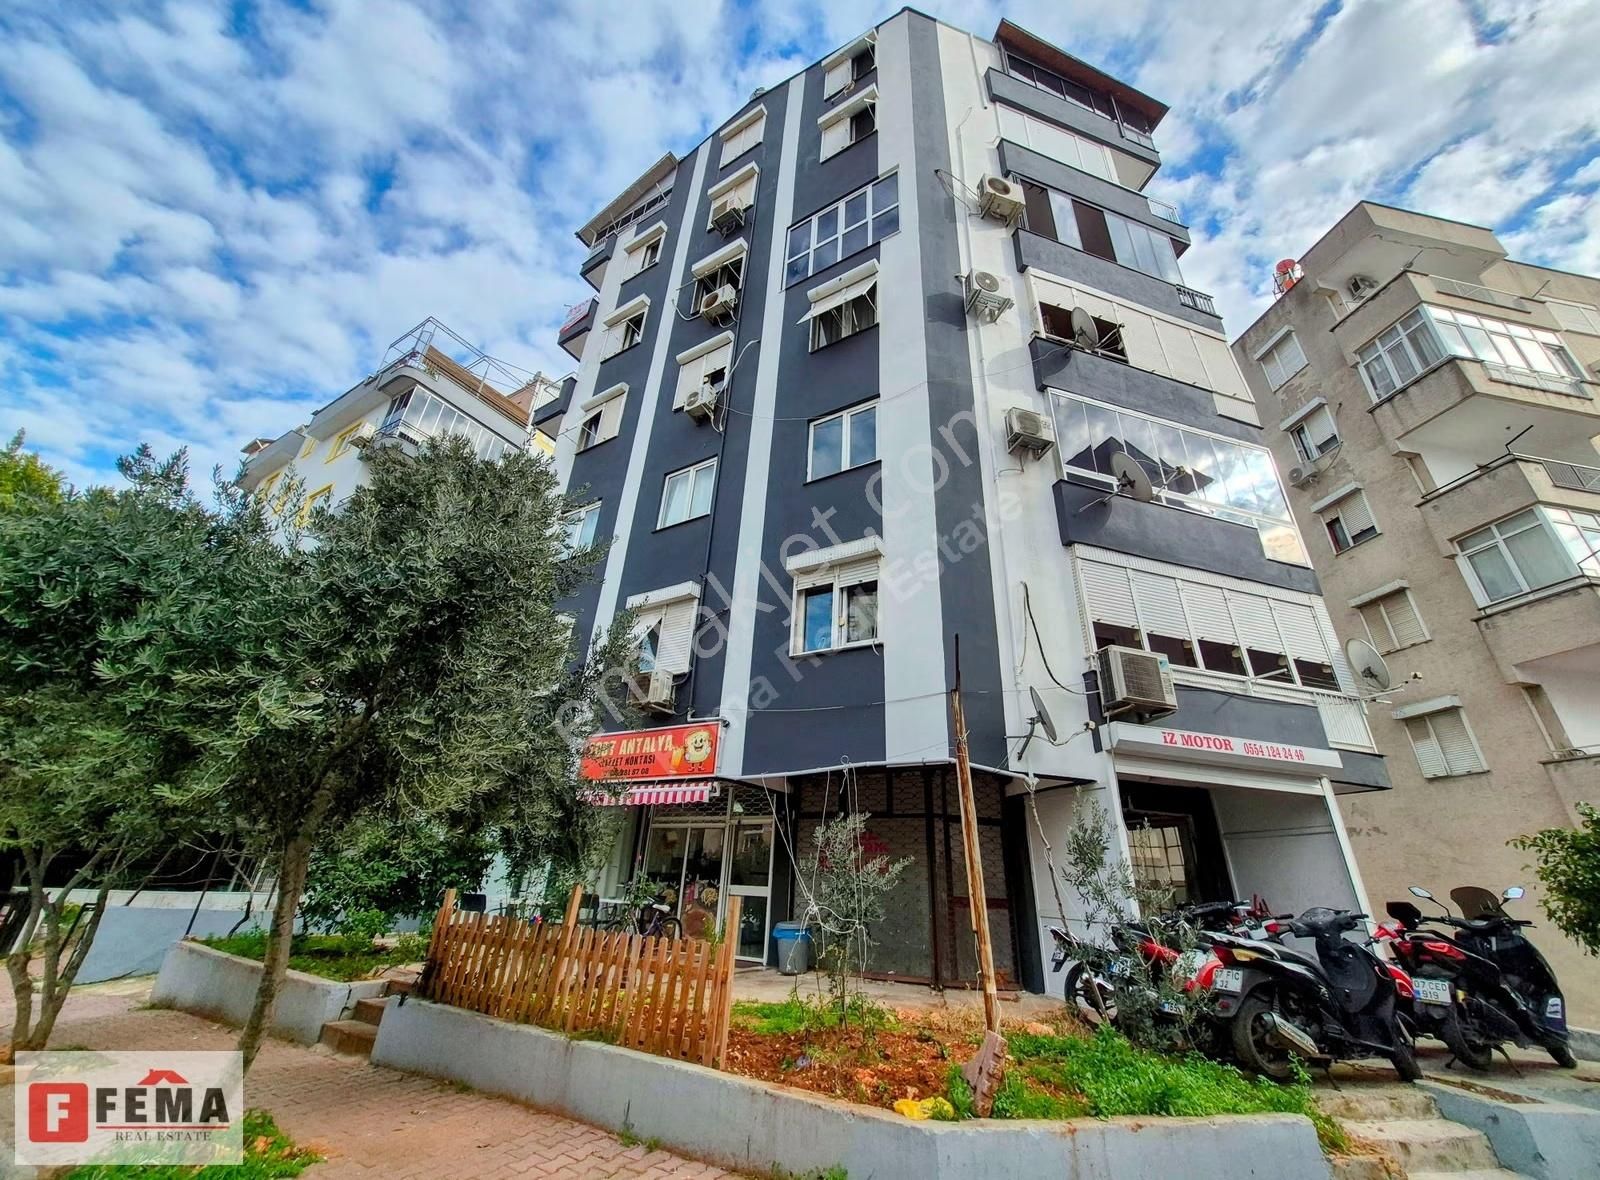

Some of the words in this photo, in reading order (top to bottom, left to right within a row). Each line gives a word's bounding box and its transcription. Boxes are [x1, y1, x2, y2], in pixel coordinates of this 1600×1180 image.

[619, 735, 673, 755] ANTALYA
[1180, 734, 1234, 751] MOTOR
[1243, 742, 1264, 756] 0554
[1266, 746, 1281, 758] 124
[1282, 747, 1293, 760] 24
[1413, 980, 1426, 988] 07
